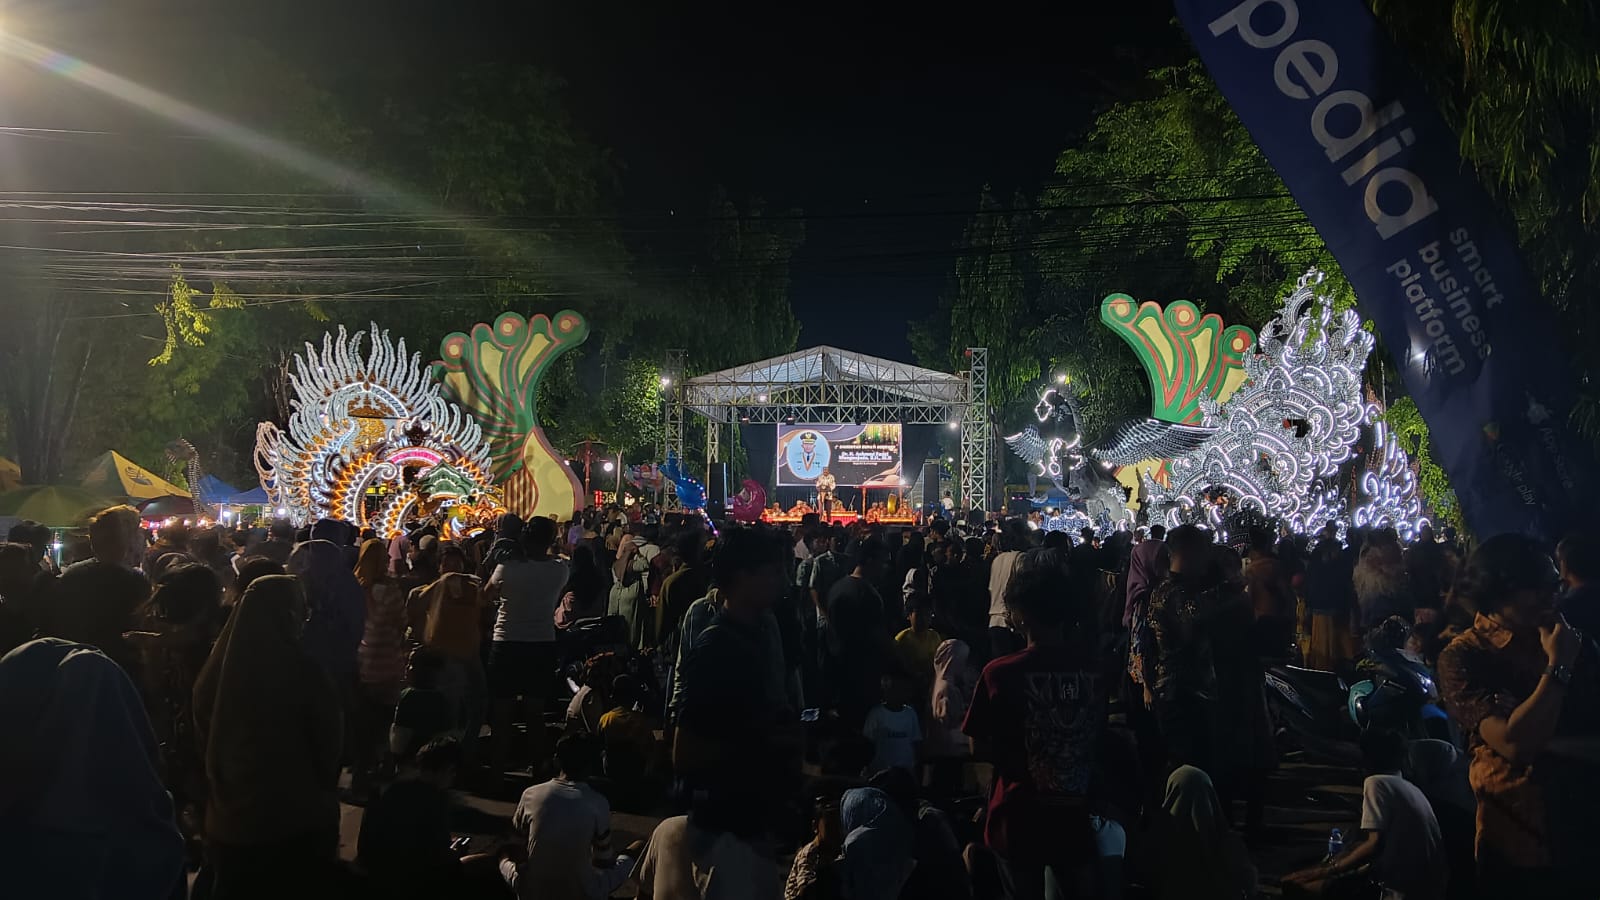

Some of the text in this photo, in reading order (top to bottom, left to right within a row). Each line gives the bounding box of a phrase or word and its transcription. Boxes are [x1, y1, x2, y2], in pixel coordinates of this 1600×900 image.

[1208, 0, 1439, 240] pedia
[1386, 258, 1465, 375] platform
[1418, 240, 1492, 360] business
[1449, 227, 1504, 309] smart
